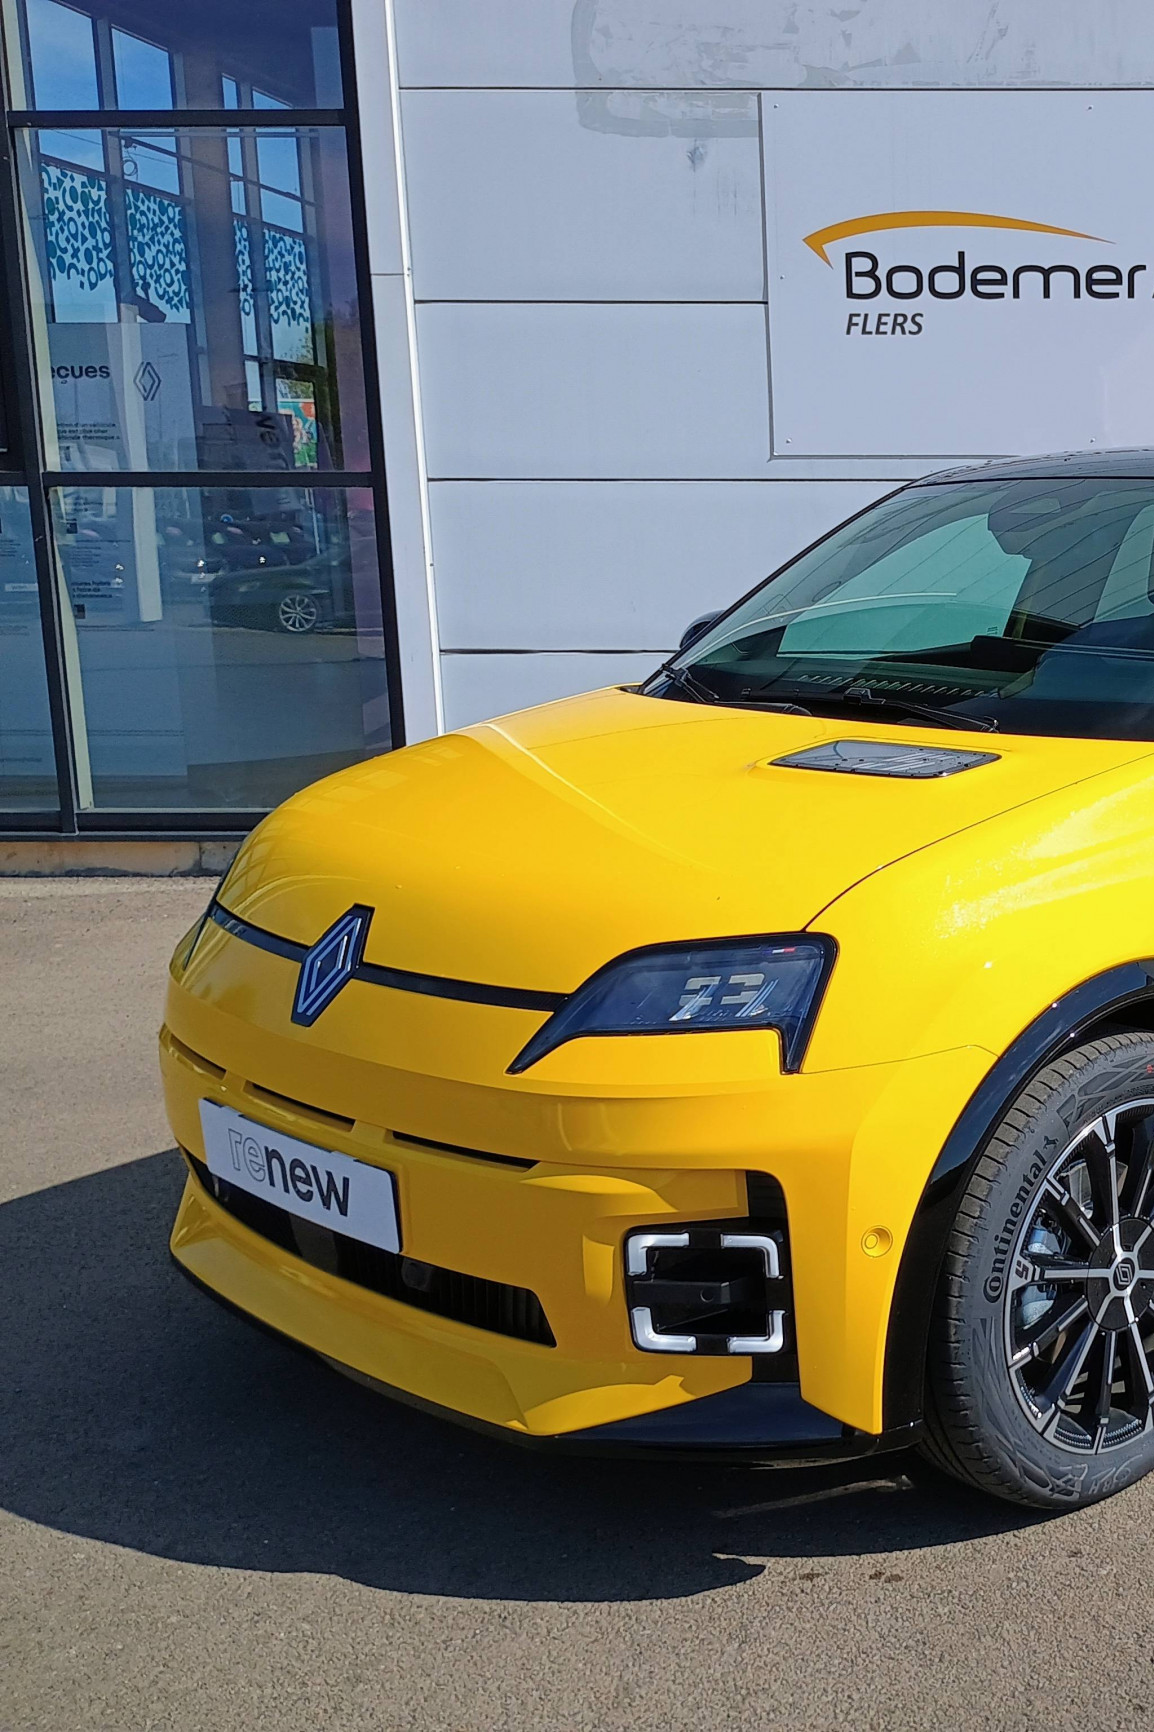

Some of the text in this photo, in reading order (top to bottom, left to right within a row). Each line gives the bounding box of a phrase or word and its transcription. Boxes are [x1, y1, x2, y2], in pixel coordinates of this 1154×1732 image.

[845, 312, 925, 336] FLERS
[227, 1128, 350, 1218] renew
[983, 1149, 1047, 1304] Continental
